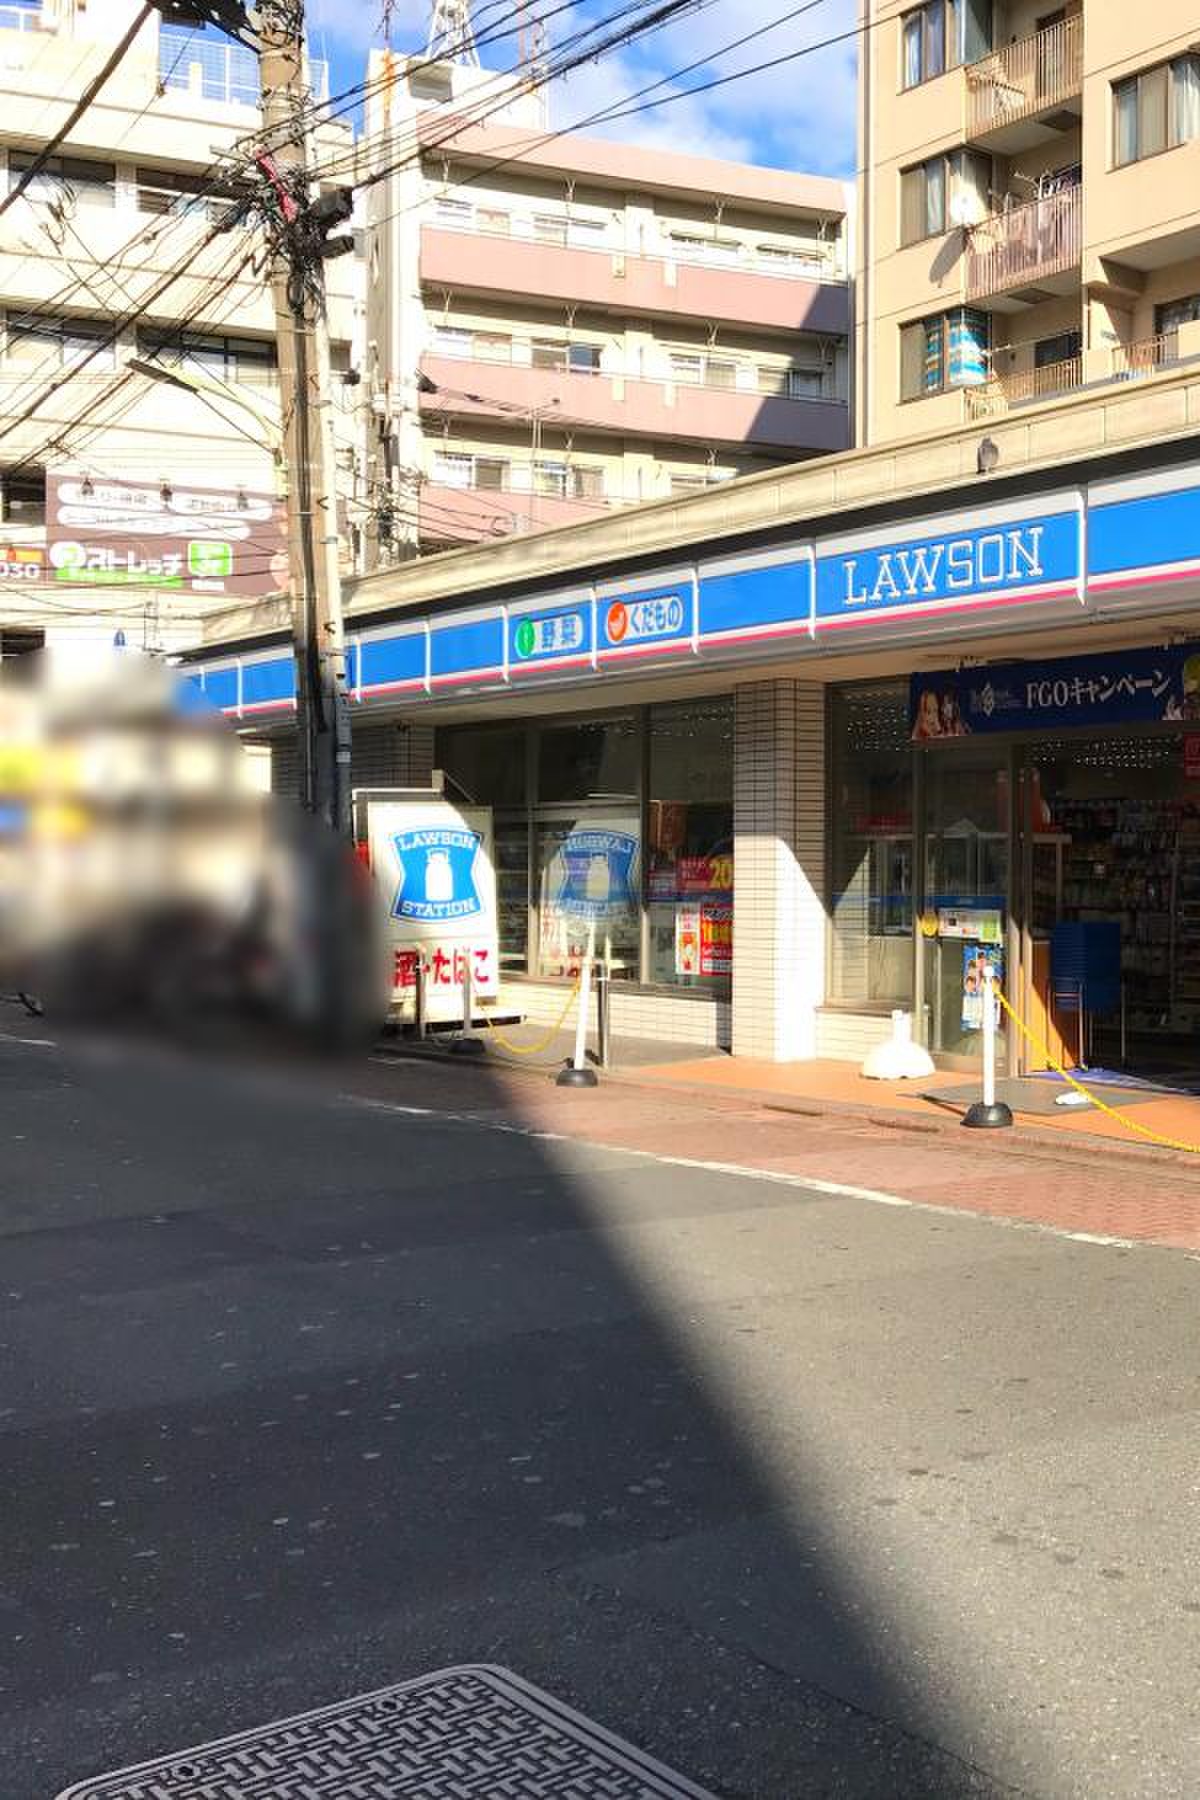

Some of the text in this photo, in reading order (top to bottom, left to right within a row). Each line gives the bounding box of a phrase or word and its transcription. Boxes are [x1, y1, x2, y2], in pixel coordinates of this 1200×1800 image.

[844, 526, 1043, 604] LAWSON
[1026, 670, 1170, 709] FGOキャンペーン
[397, 831, 478, 850] LAWSON
[400, 898, 477, 918] STATION
